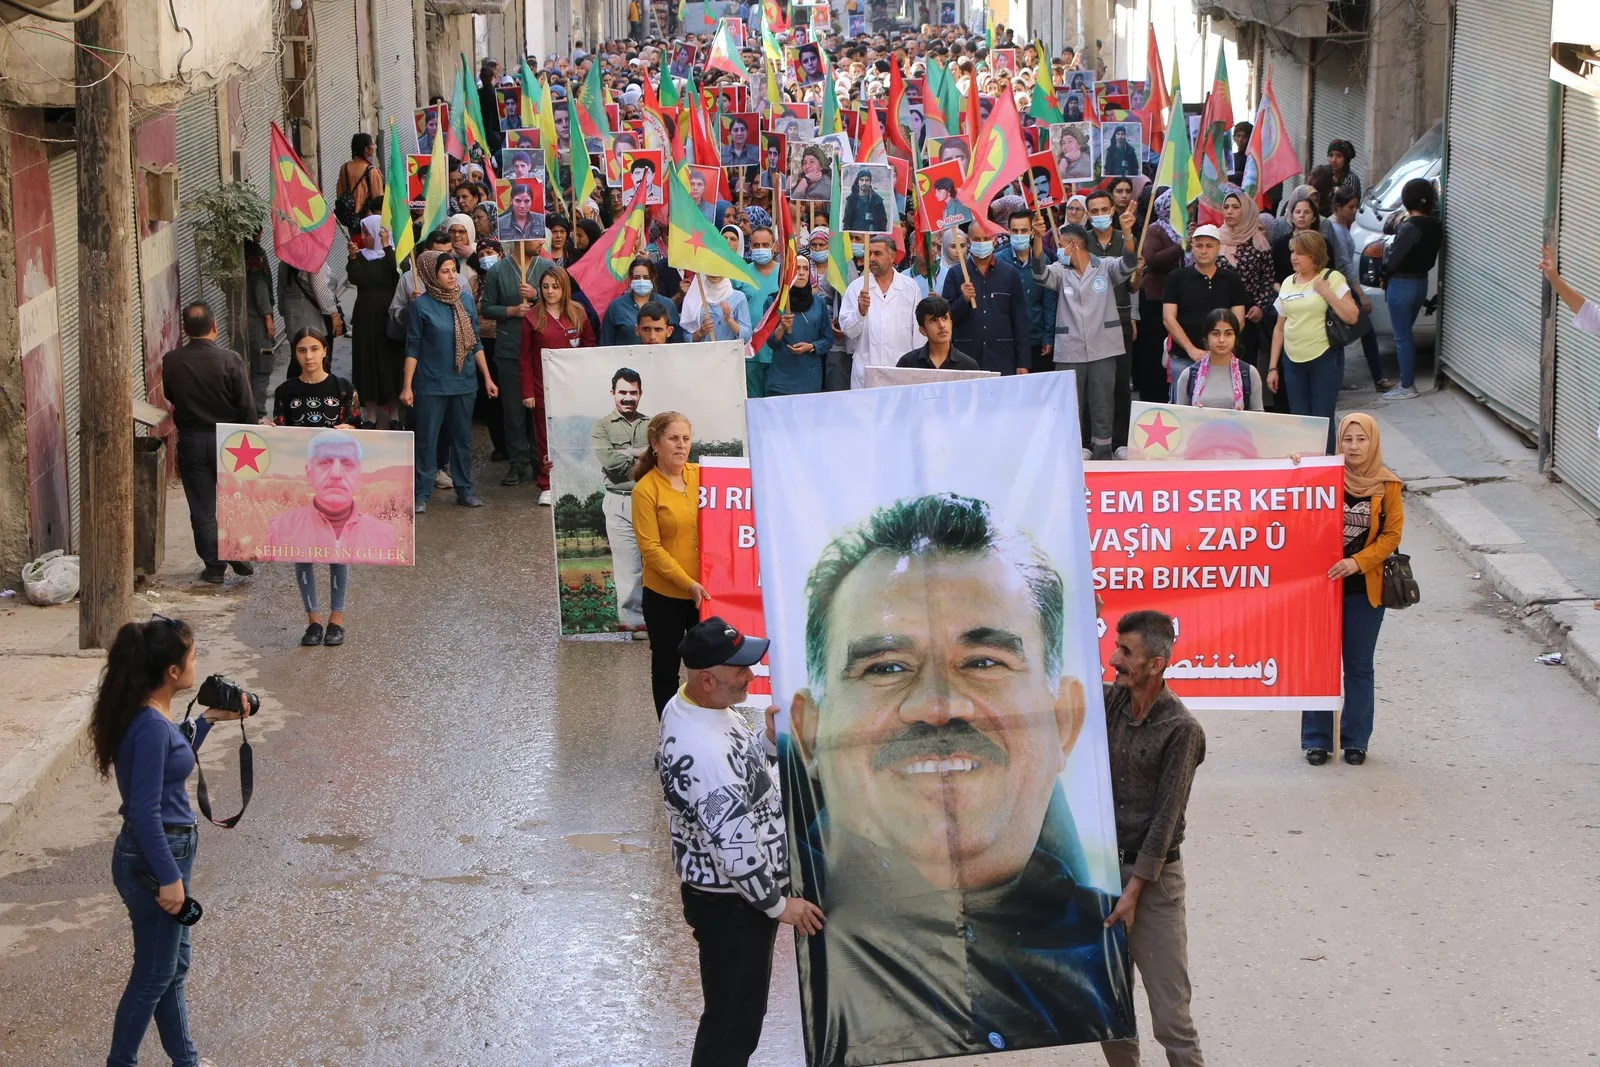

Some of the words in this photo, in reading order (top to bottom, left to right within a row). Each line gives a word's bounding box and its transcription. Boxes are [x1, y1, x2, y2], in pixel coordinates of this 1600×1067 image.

[1101, 490, 1144, 513] EM
[1152, 490, 1179, 513] BI
[1187, 488, 1242, 512] SER
[1251, 485, 1336, 511] KETIN
[1198, 527, 1257, 551] ZAP
[1266, 521, 1286, 550] Û
[1092, 566, 1144, 590] SER
[1152, 565, 1270, 590] BIKEVIN
[1163, 654, 1278, 687] وسننتص
